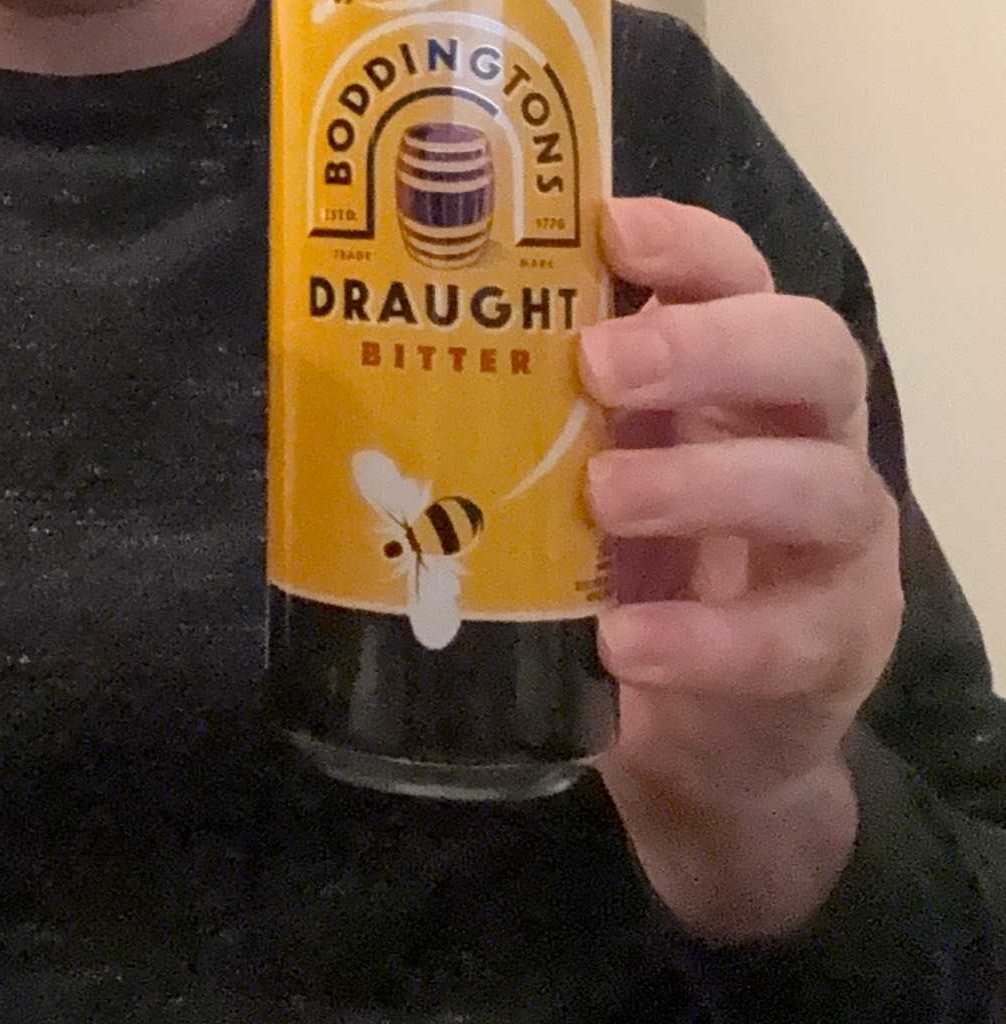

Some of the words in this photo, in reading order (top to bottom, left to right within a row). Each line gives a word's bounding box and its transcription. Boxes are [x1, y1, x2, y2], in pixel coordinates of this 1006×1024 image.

[325, 39, 564, 193] BODDINGTONS
[309, 276, 578, 330] DRAUGHT
[361, 341, 531, 374] BITTER
